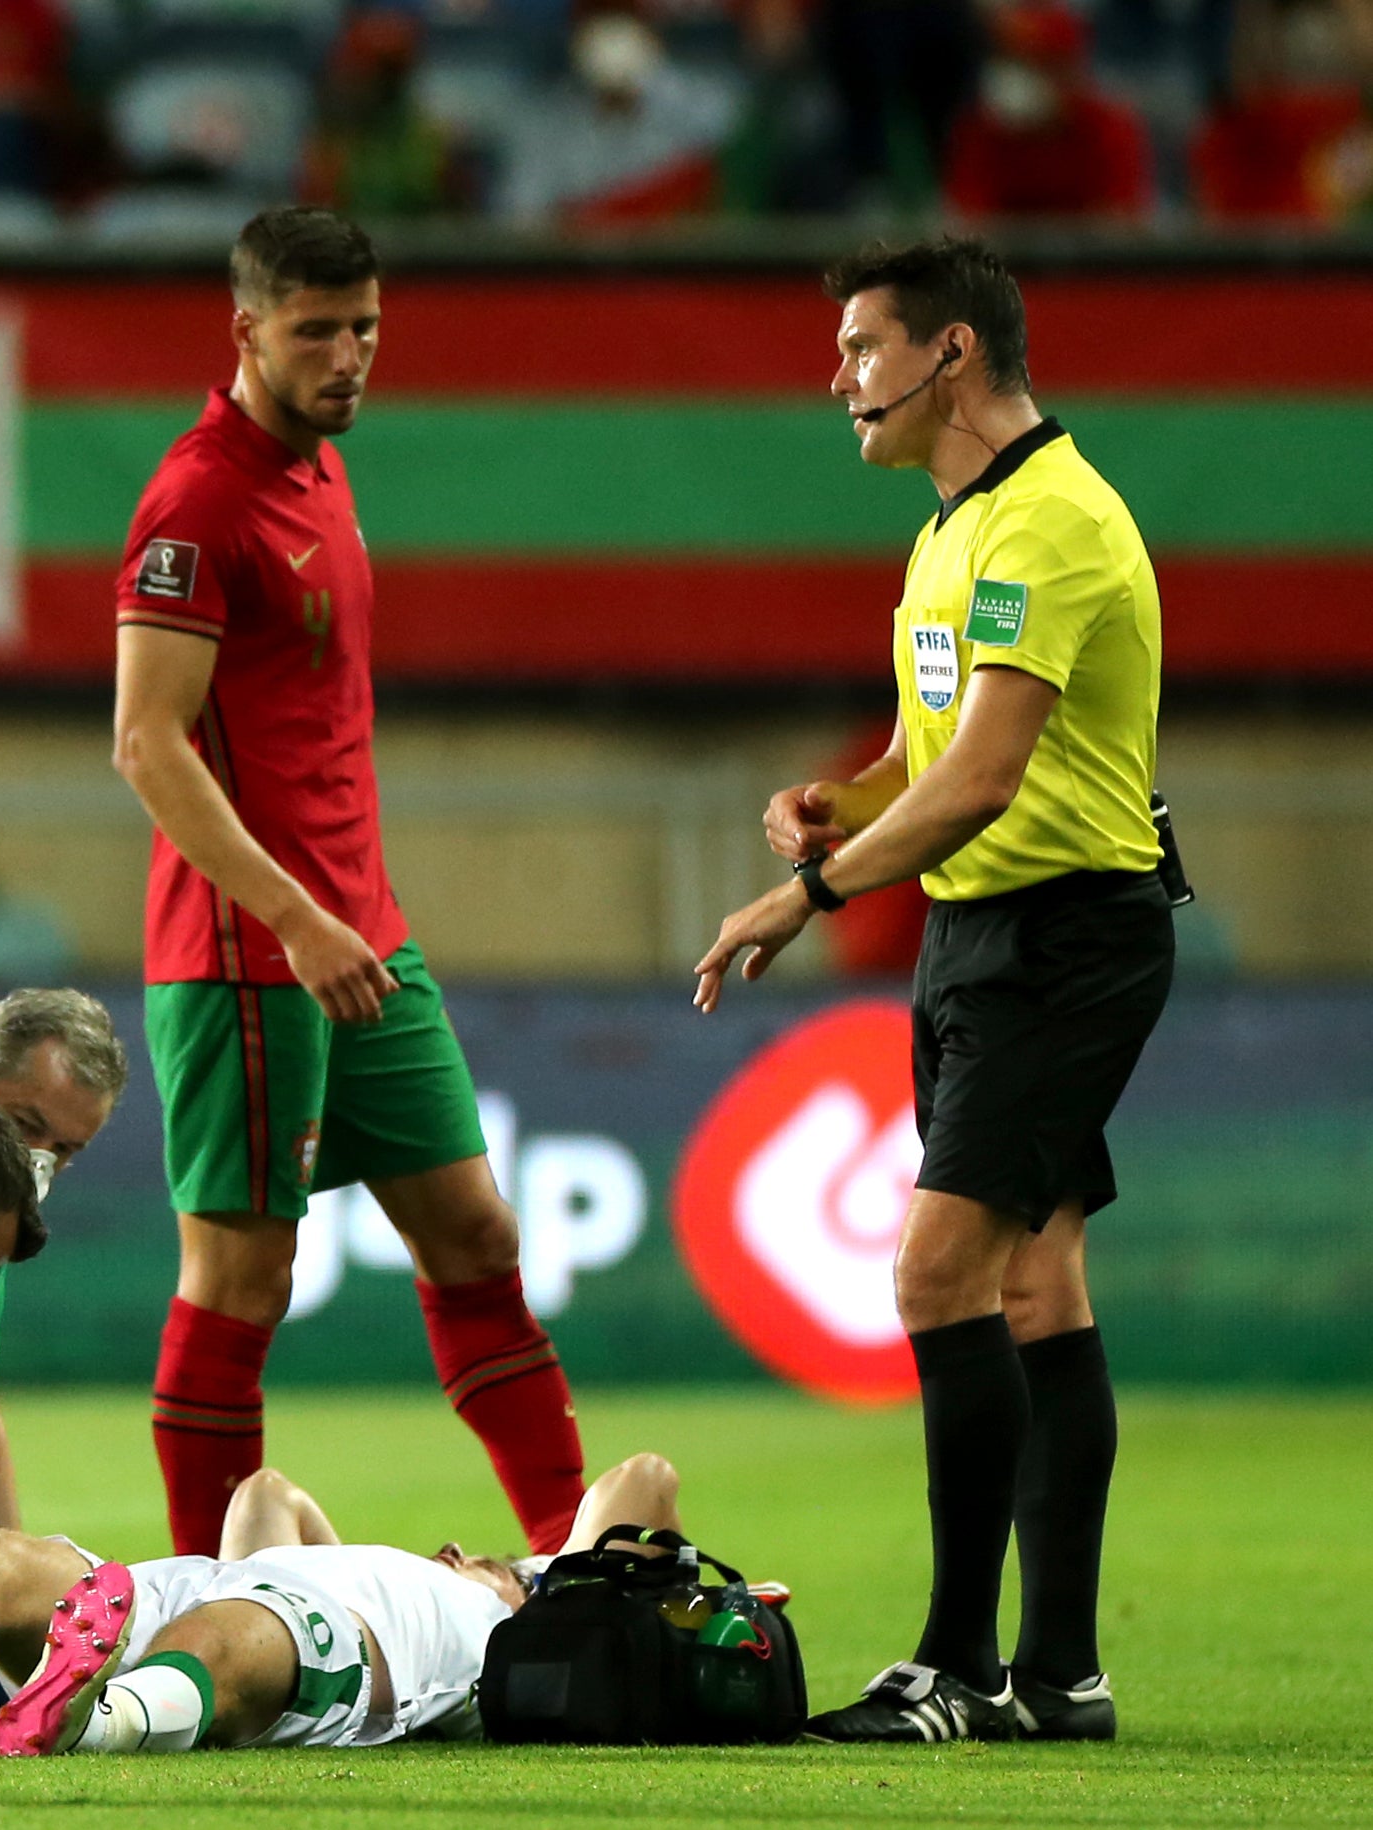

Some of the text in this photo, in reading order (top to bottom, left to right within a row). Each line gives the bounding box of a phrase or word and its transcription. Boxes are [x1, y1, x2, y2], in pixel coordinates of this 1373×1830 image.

[977, 596, 1022, 609] LIVING
[975, 604, 1019, 616] FOOTBALL
[303, 588, 331, 670] 4
[996, 620, 1017, 630] FIFA
[915, 631, 952, 651] FIFA
[919, 664, 954, 677] REFEREE
